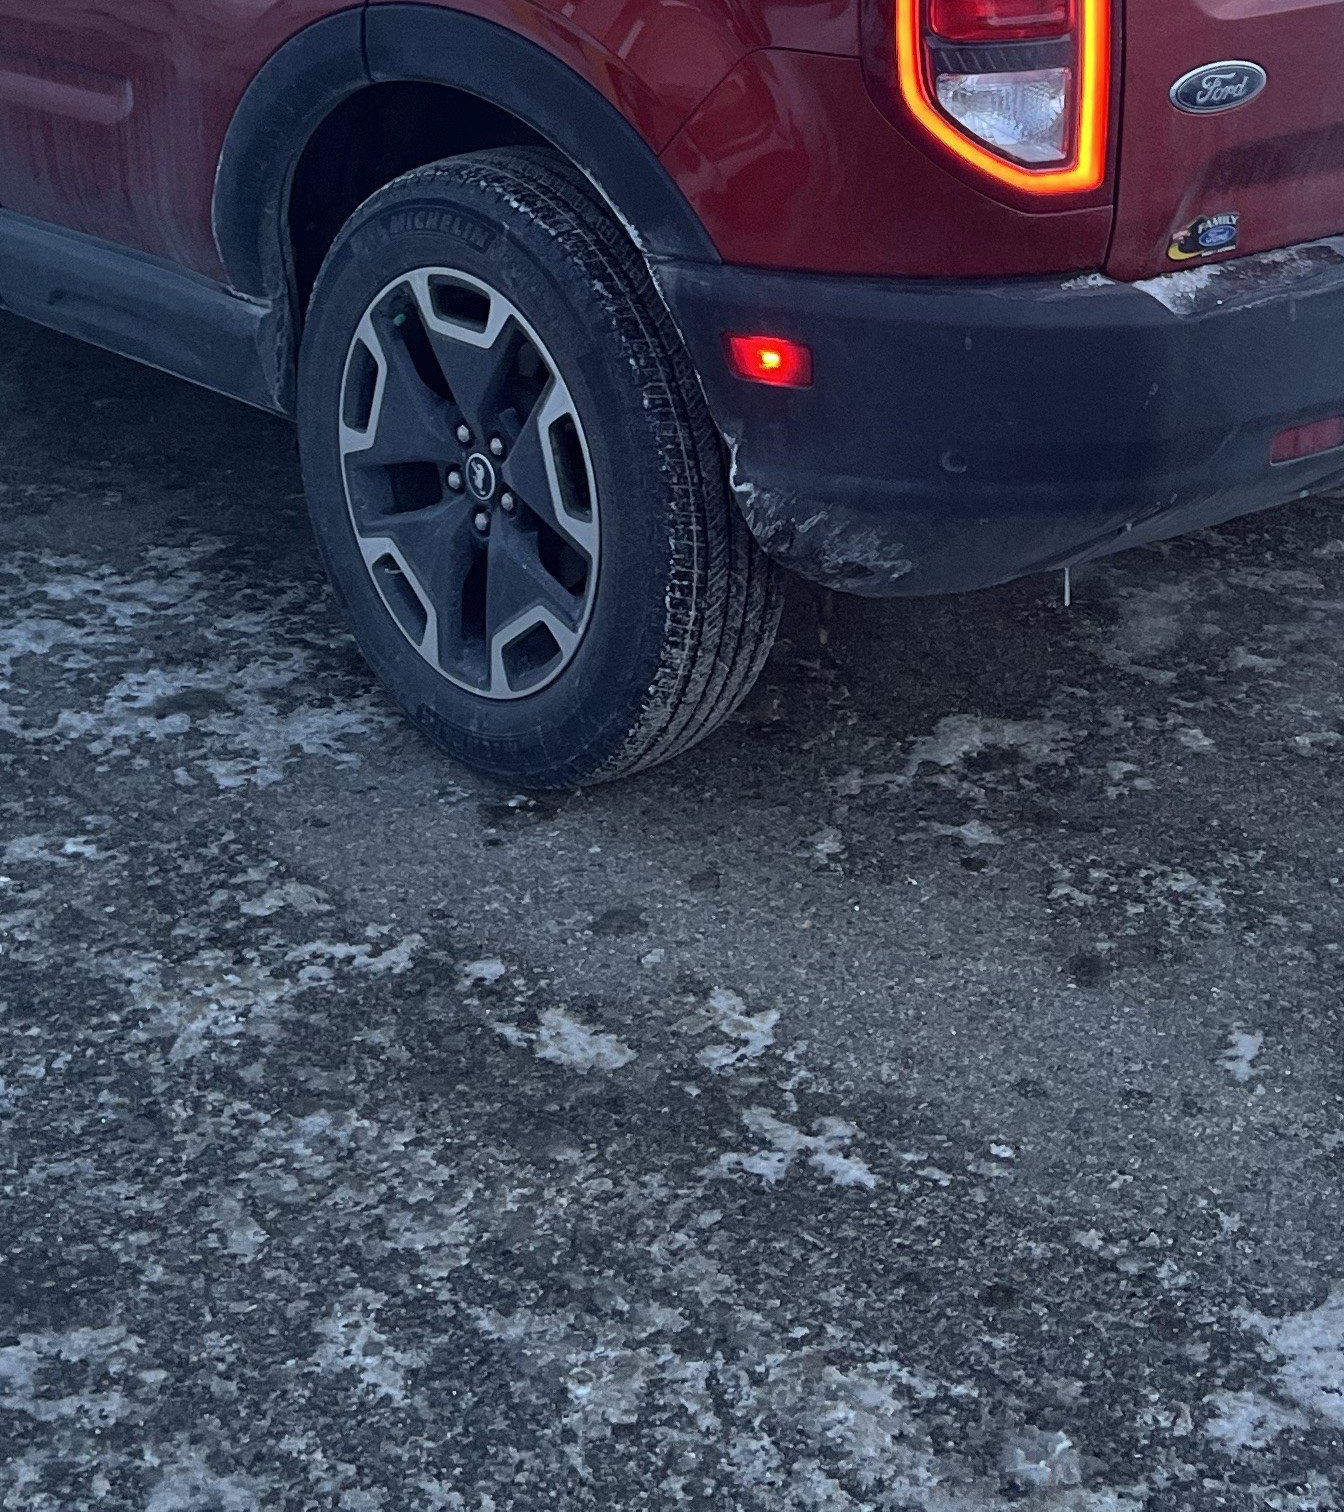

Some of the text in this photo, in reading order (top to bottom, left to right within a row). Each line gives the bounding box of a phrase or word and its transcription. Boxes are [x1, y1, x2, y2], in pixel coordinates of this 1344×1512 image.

[1196, 72, 1249, 104] Ford
[389, 210, 490, 249] MICHELIN
[1197, 214, 1240, 235] FAMILY
